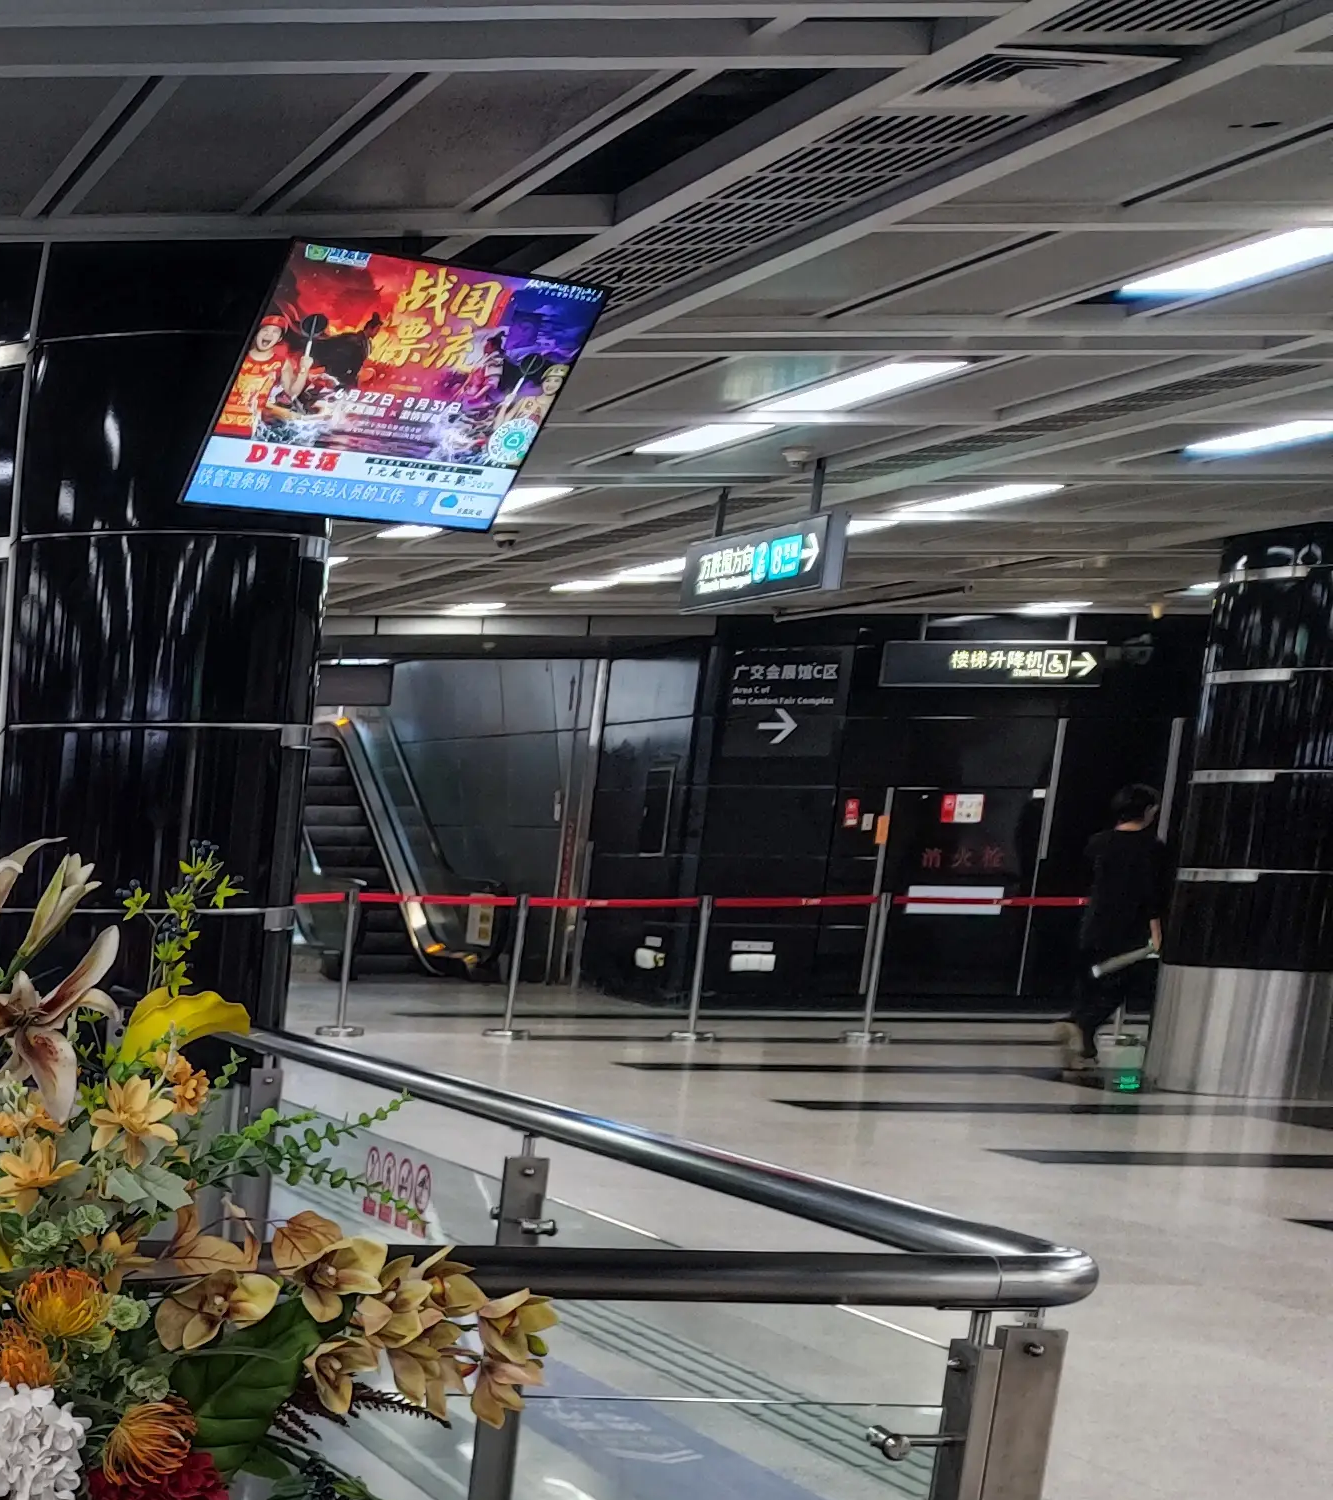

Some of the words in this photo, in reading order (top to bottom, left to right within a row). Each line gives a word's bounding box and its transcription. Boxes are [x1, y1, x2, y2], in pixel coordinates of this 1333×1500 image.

[397, 267, 503, 327] 战国
[369, 317, 477, 375] 漂流
[245, 444, 341, 471] DT生活
[950, 650, 1043, 669] 楼梯升降机
[922, 842, 1006, 870] 消火栓
